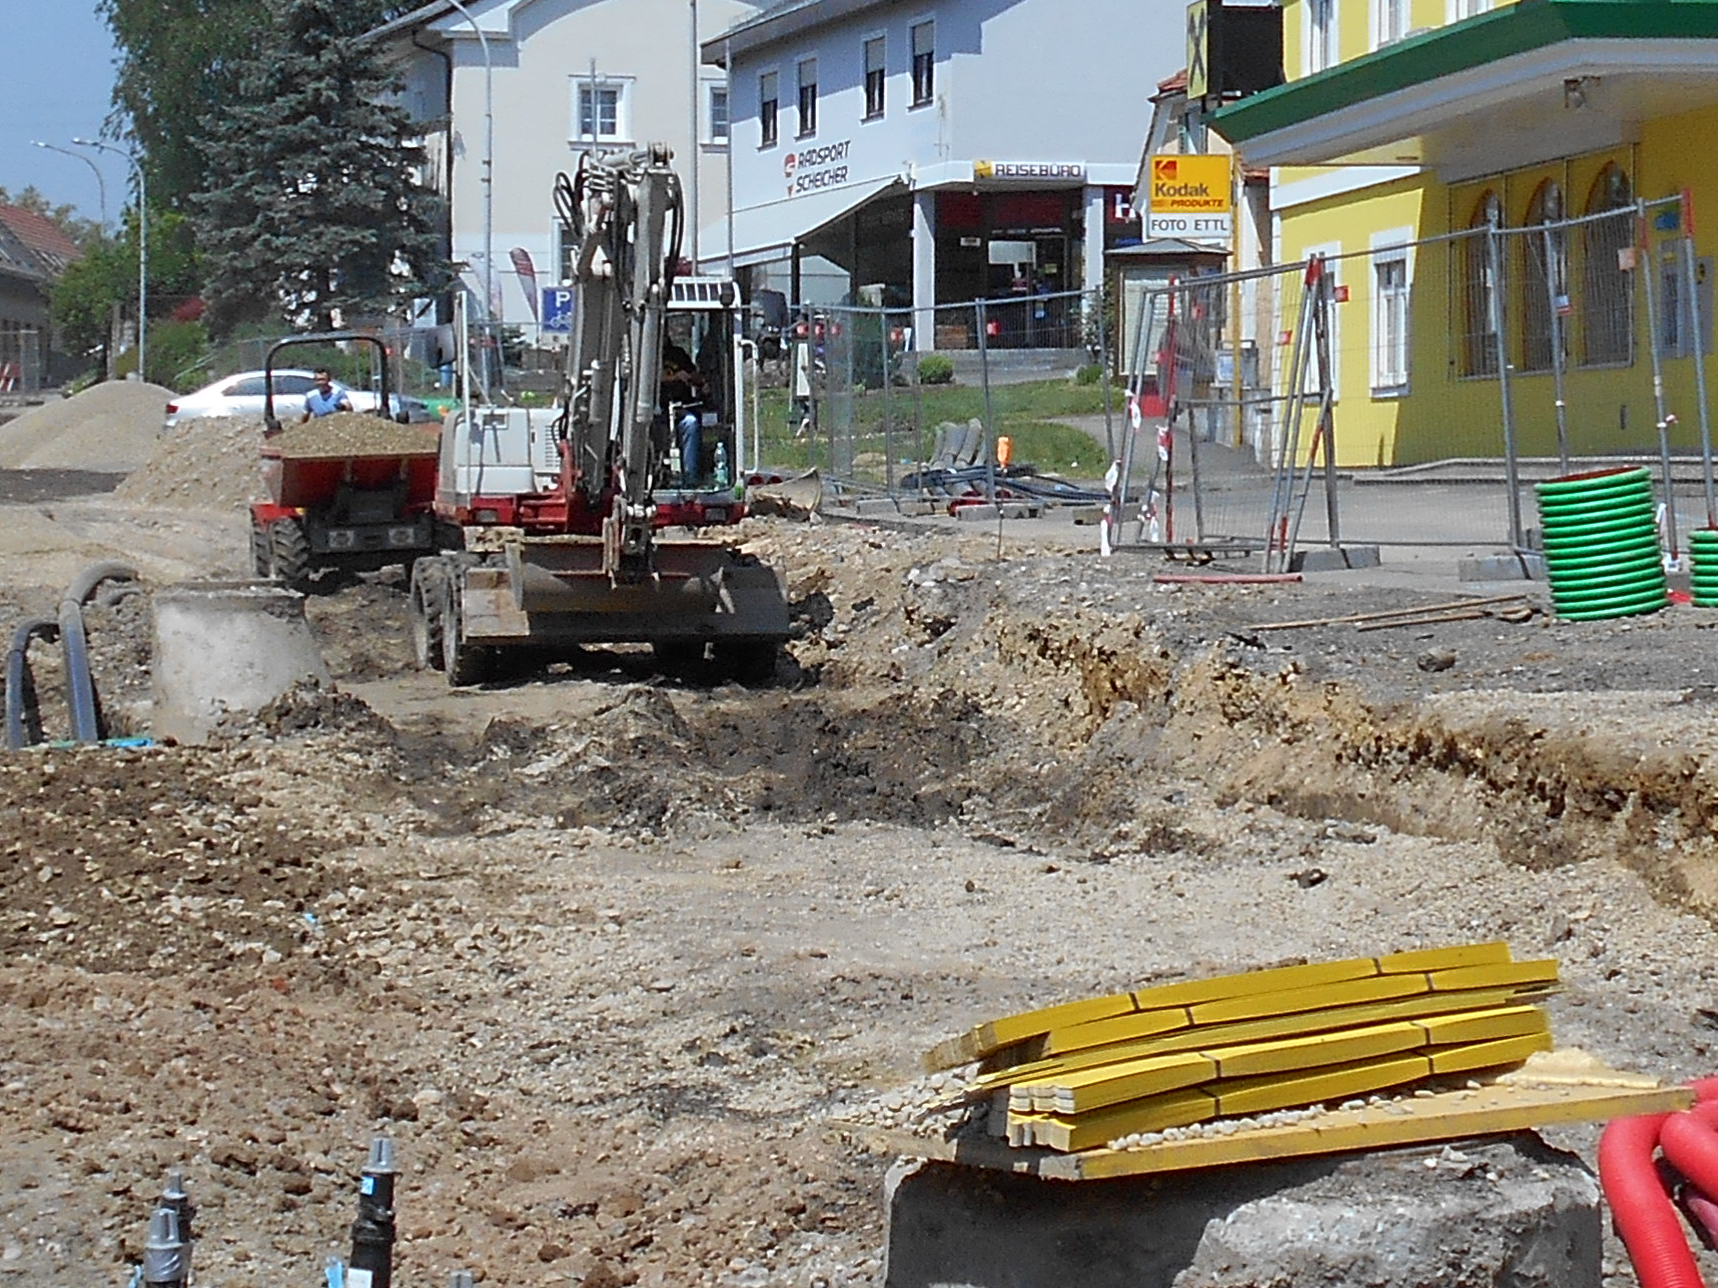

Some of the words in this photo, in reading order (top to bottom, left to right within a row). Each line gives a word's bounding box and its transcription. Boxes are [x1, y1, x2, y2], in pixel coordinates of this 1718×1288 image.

[797, 140, 851, 169] RADSPORT
[995, 163, 1081, 178] REISEBÜRO
[1154, 183, 1209, 197] Kodak
[1151, 219, 1187, 231] FOTO
[1194, 219, 1227, 231] ETTL
[555, 291, 571, 308] P
